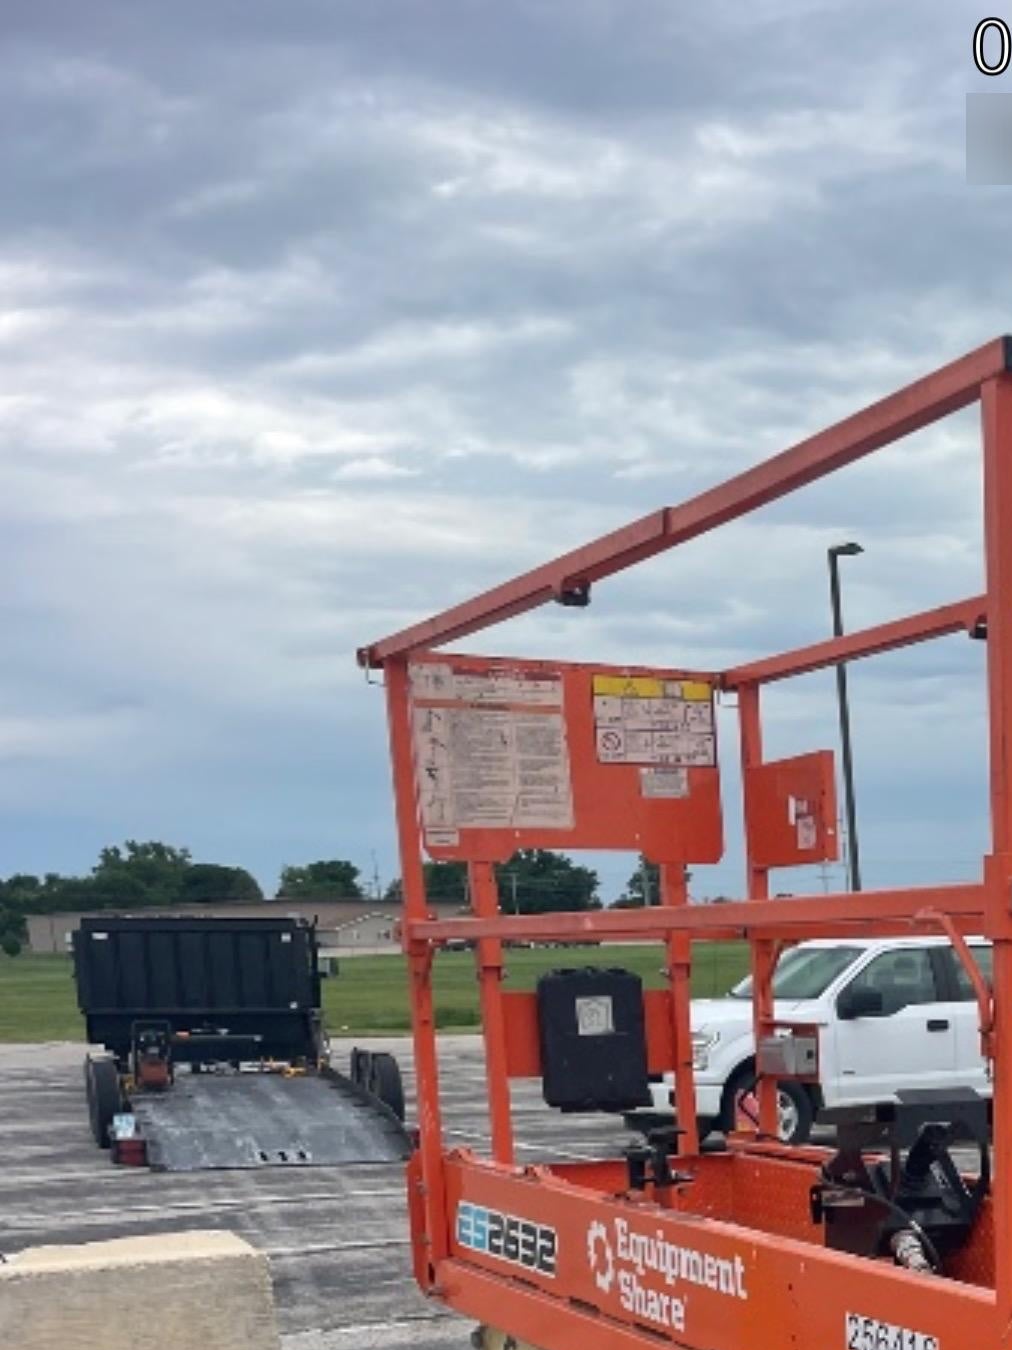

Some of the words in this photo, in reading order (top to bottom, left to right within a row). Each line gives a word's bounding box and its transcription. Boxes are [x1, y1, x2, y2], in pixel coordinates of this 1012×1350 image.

[457, 1205, 556, 1273] ES2632
[614, 1217, 747, 1300] Equipment
[617, 1269, 685, 1332] Share
